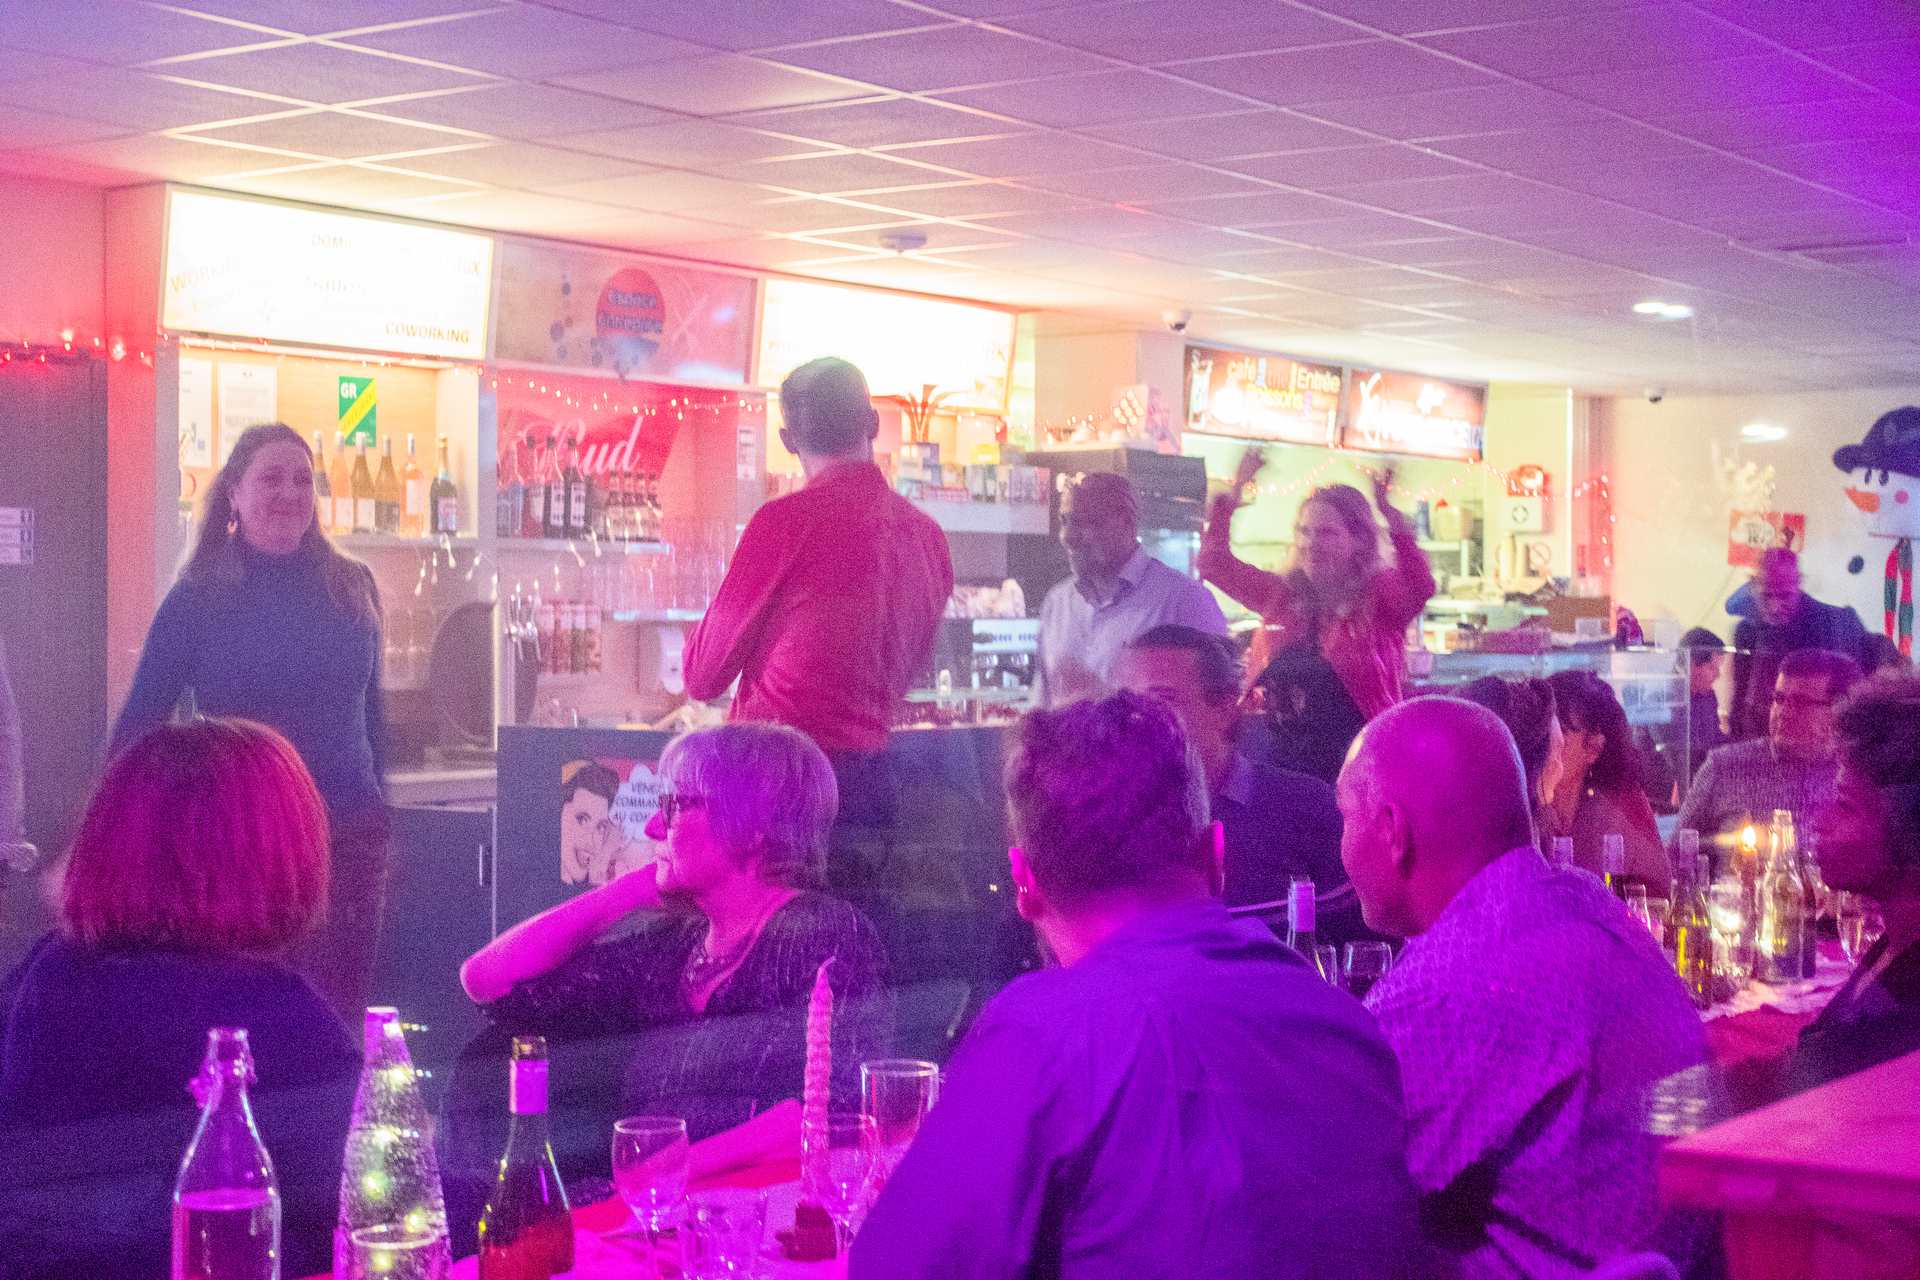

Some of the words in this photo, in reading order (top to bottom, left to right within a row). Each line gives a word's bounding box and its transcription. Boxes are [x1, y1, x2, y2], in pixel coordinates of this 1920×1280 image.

[384, 320, 470, 344] COWORKING
[340, 382, 357, 399] GR
[615, 796, 659, 809] COMMAN
